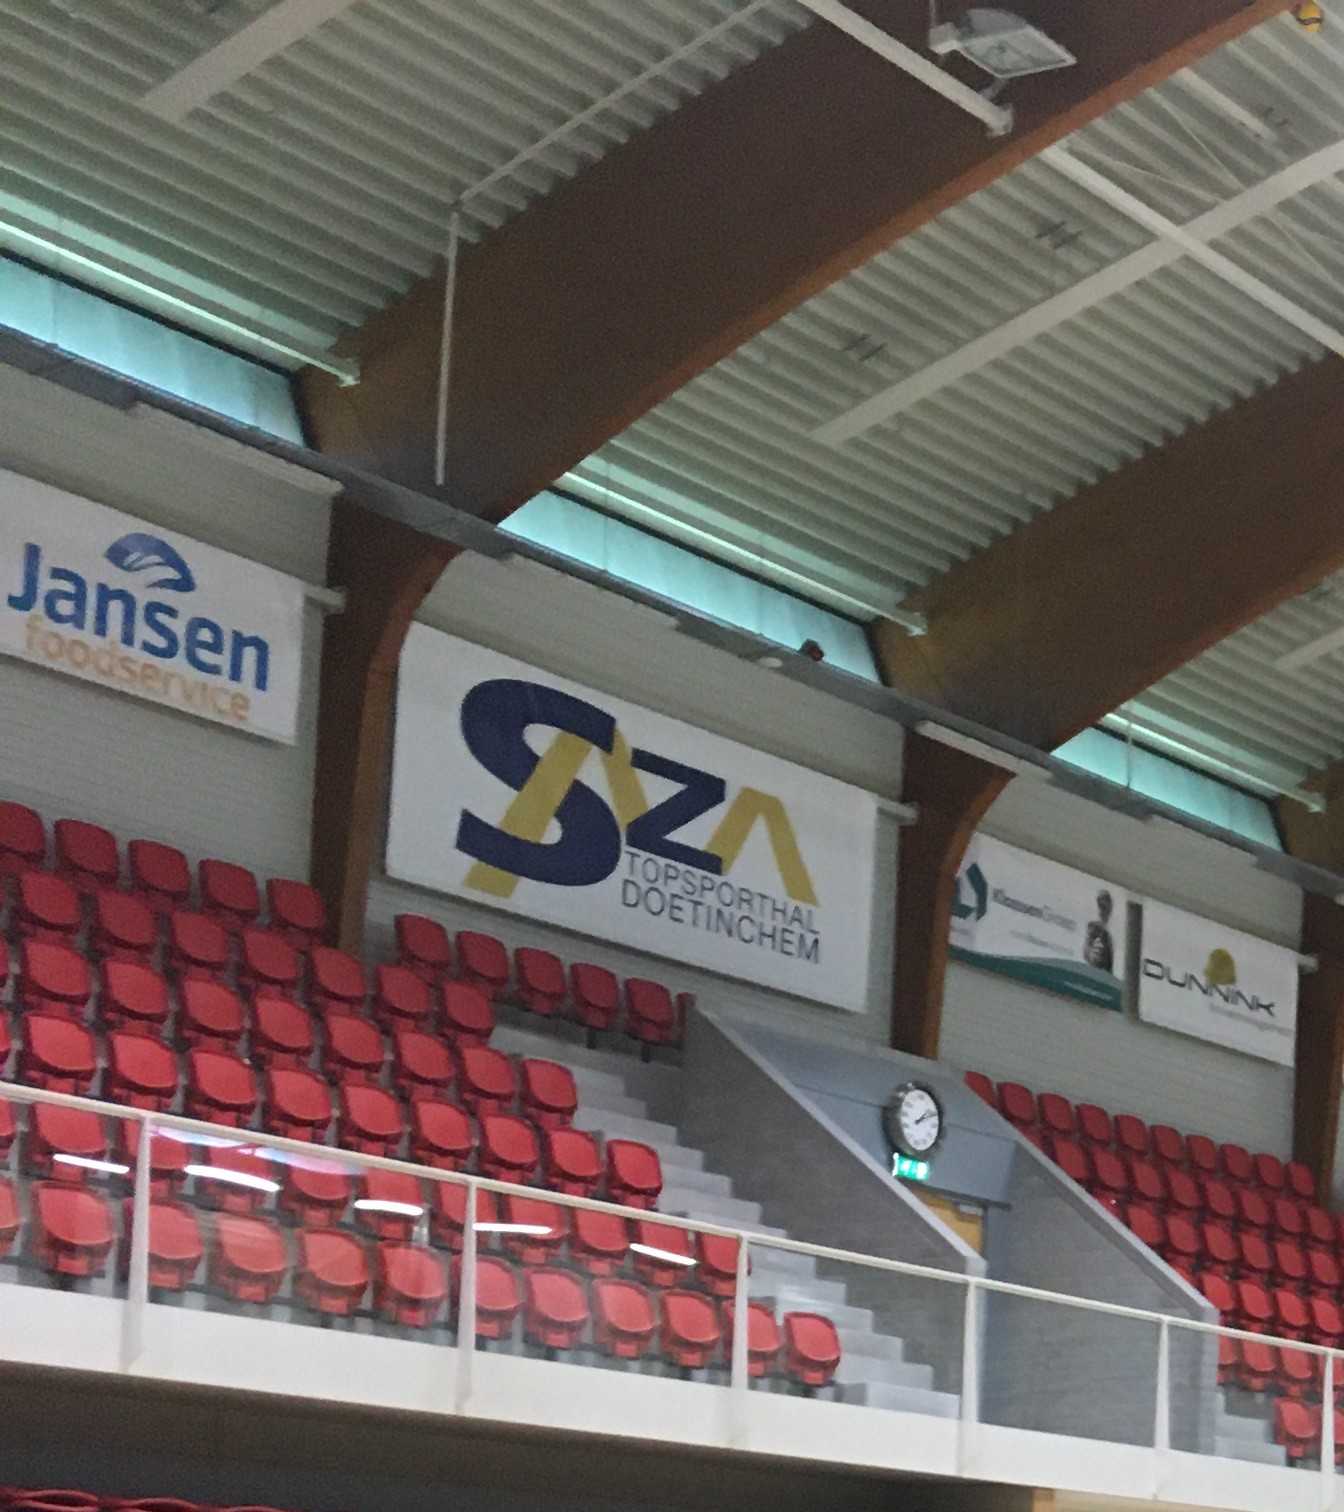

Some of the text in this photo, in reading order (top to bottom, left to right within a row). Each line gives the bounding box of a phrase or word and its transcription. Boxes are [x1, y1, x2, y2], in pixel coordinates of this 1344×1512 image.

[7, 542, 270, 692] Jansen
[25, 614, 251, 721] foodservice
[621, 878, 821, 964] DOETINCHEM
[624, 850, 821, 935] TOPSPORTHAL
[1142, 958, 1276, 1017] DUNNINK
